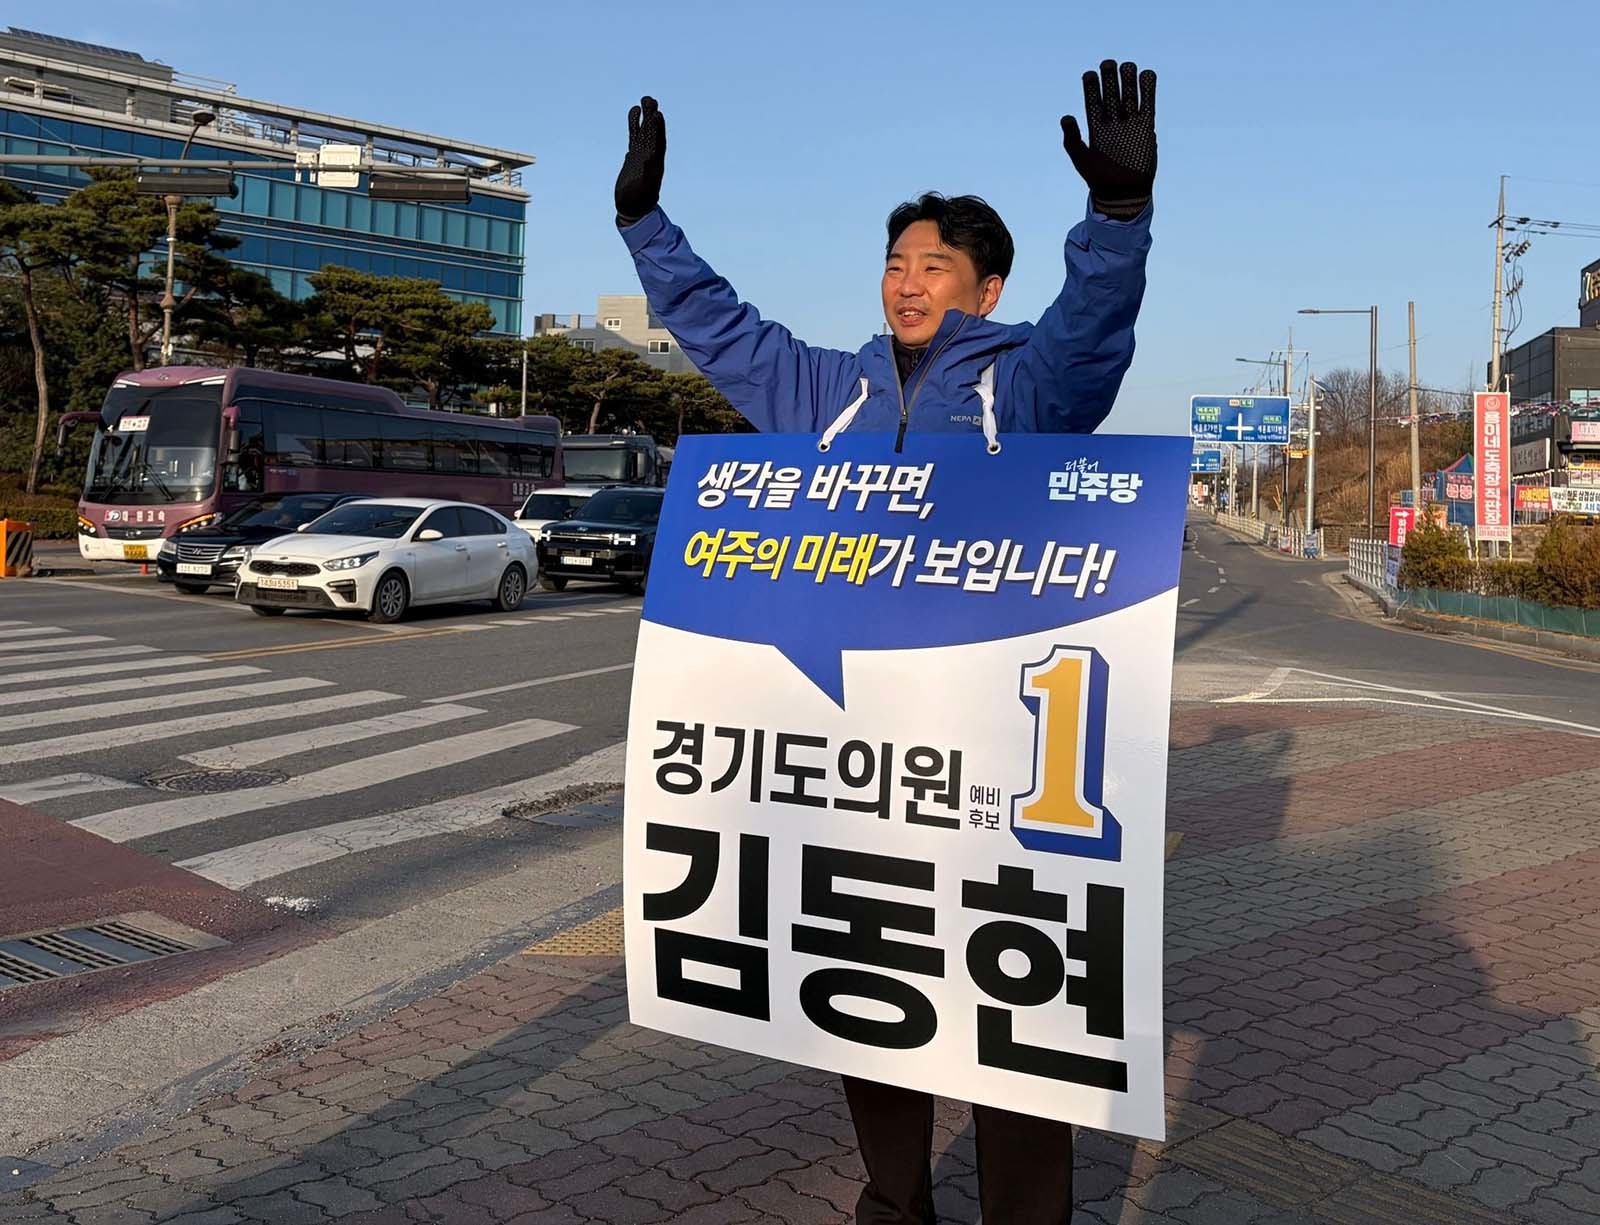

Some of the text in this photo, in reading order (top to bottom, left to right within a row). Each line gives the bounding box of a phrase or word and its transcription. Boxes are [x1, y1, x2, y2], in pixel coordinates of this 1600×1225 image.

[950, 415, 972, 423] NEPA
[1048, 471, 1143, 504] 민주당
[1064, 456, 1099, 474] 더불어
[697, 461, 935, 519] 생각을 바꾸면,
[683, 528, 1117, 599] 여주의 미래가 보입니다!
[1014, 648, 1112, 848] 1
[653, 720, 963, 830] 경기도의원
[968, 784, 1000, 807] 예비
[968, 809, 1000, 831] 후보
[643, 821, 1128, 1093] 김동현
